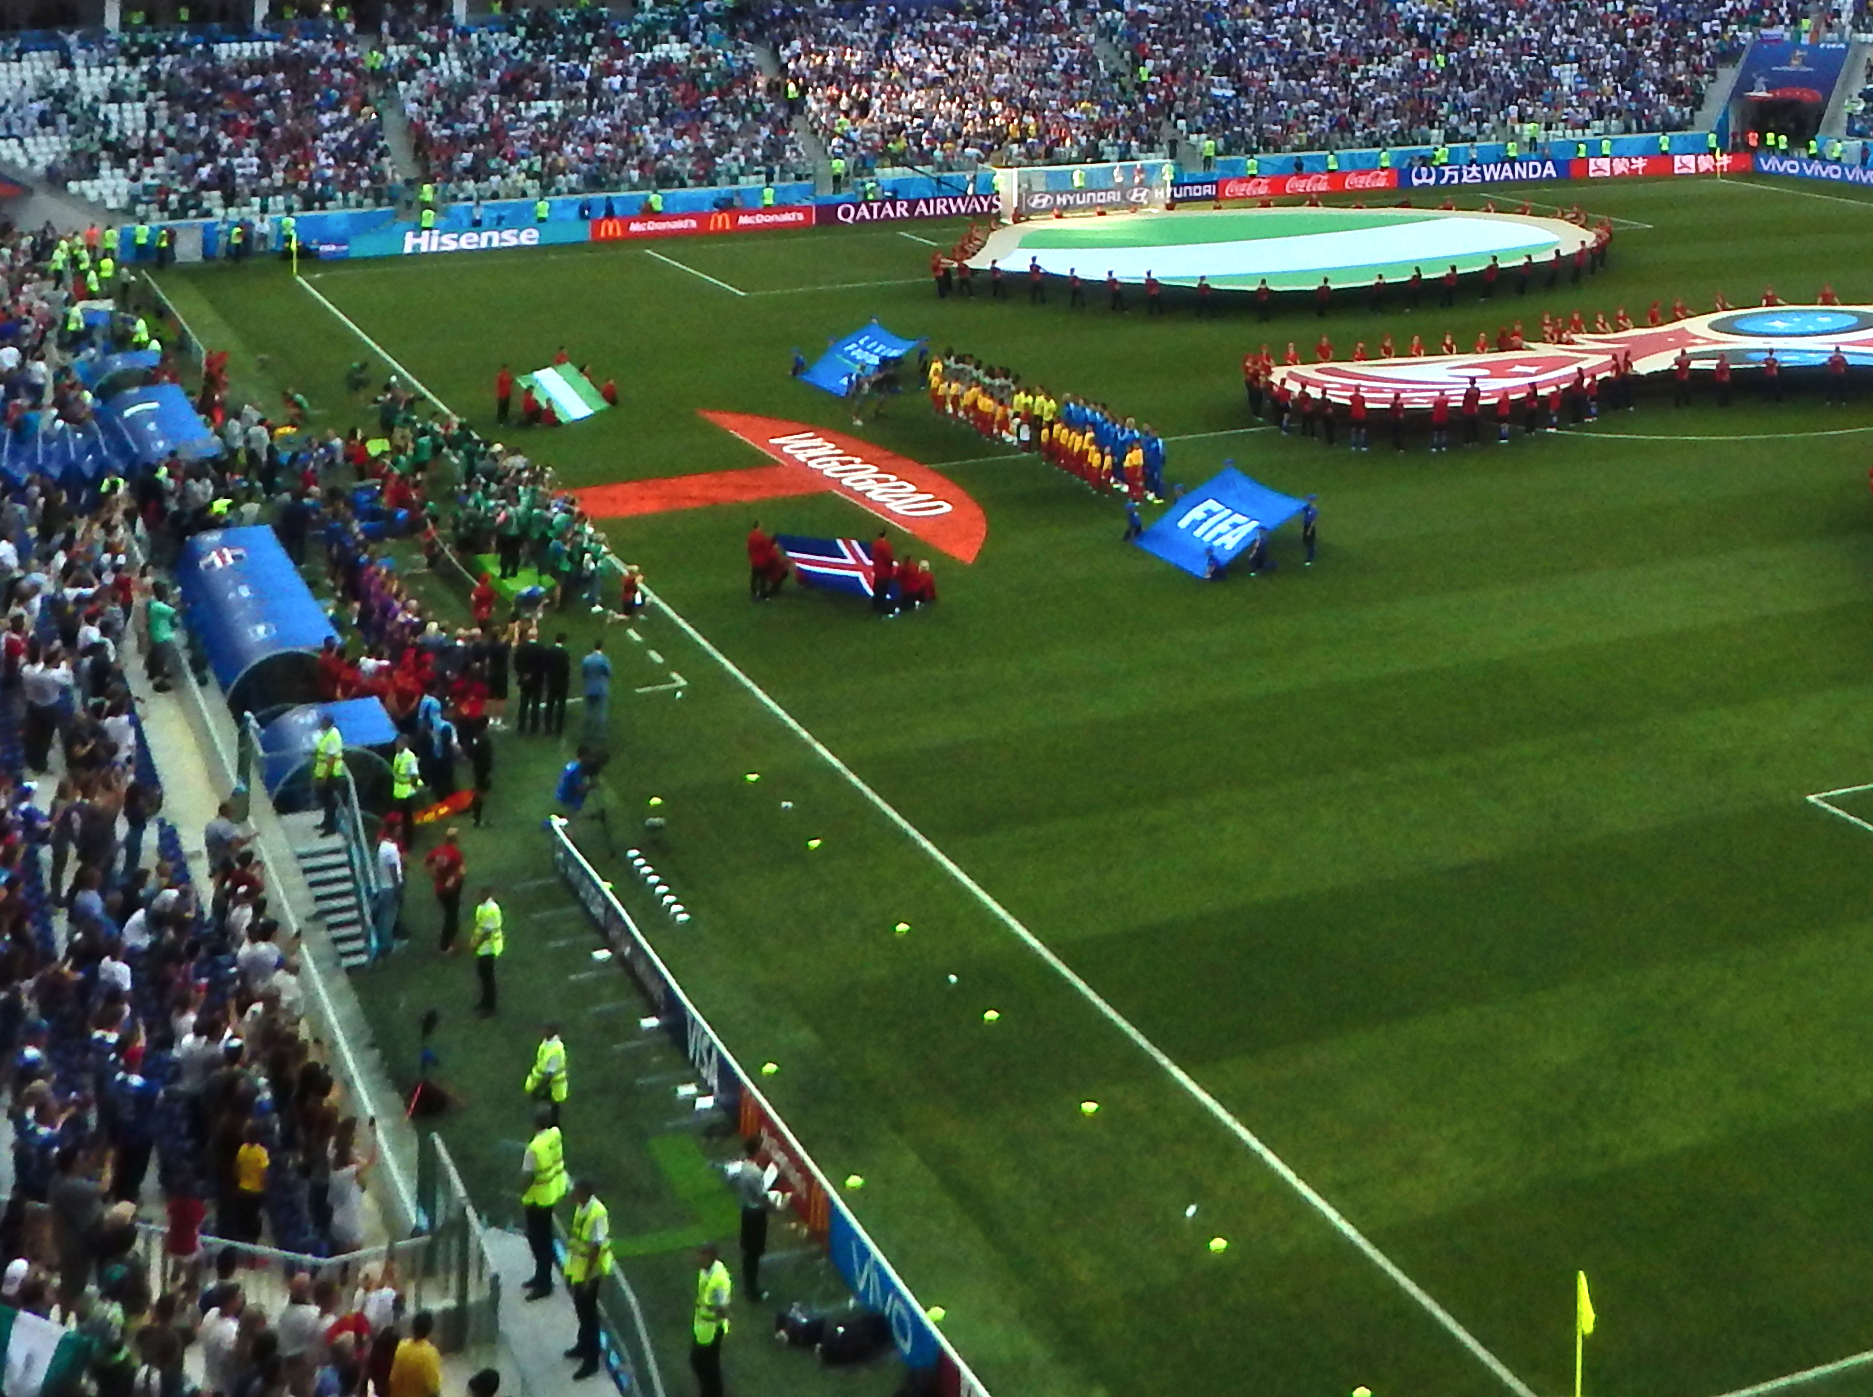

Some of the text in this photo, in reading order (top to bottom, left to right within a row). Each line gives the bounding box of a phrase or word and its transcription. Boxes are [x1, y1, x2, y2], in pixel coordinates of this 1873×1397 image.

[1483, 160, 1557, 181] WANDA
[837, 195, 1002, 224] QATAR AIRWAYS
[1056, 190, 1121, 206] HYUNDAI
[629, 218, 697, 232] McDonald's
[738, 211, 804, 225] McDonald's
[403, 226, 539, 254] Hisense
[768, 431, 953, 517] VOLGOGRAD
[1177, 498, 1260, 550] FIFA
